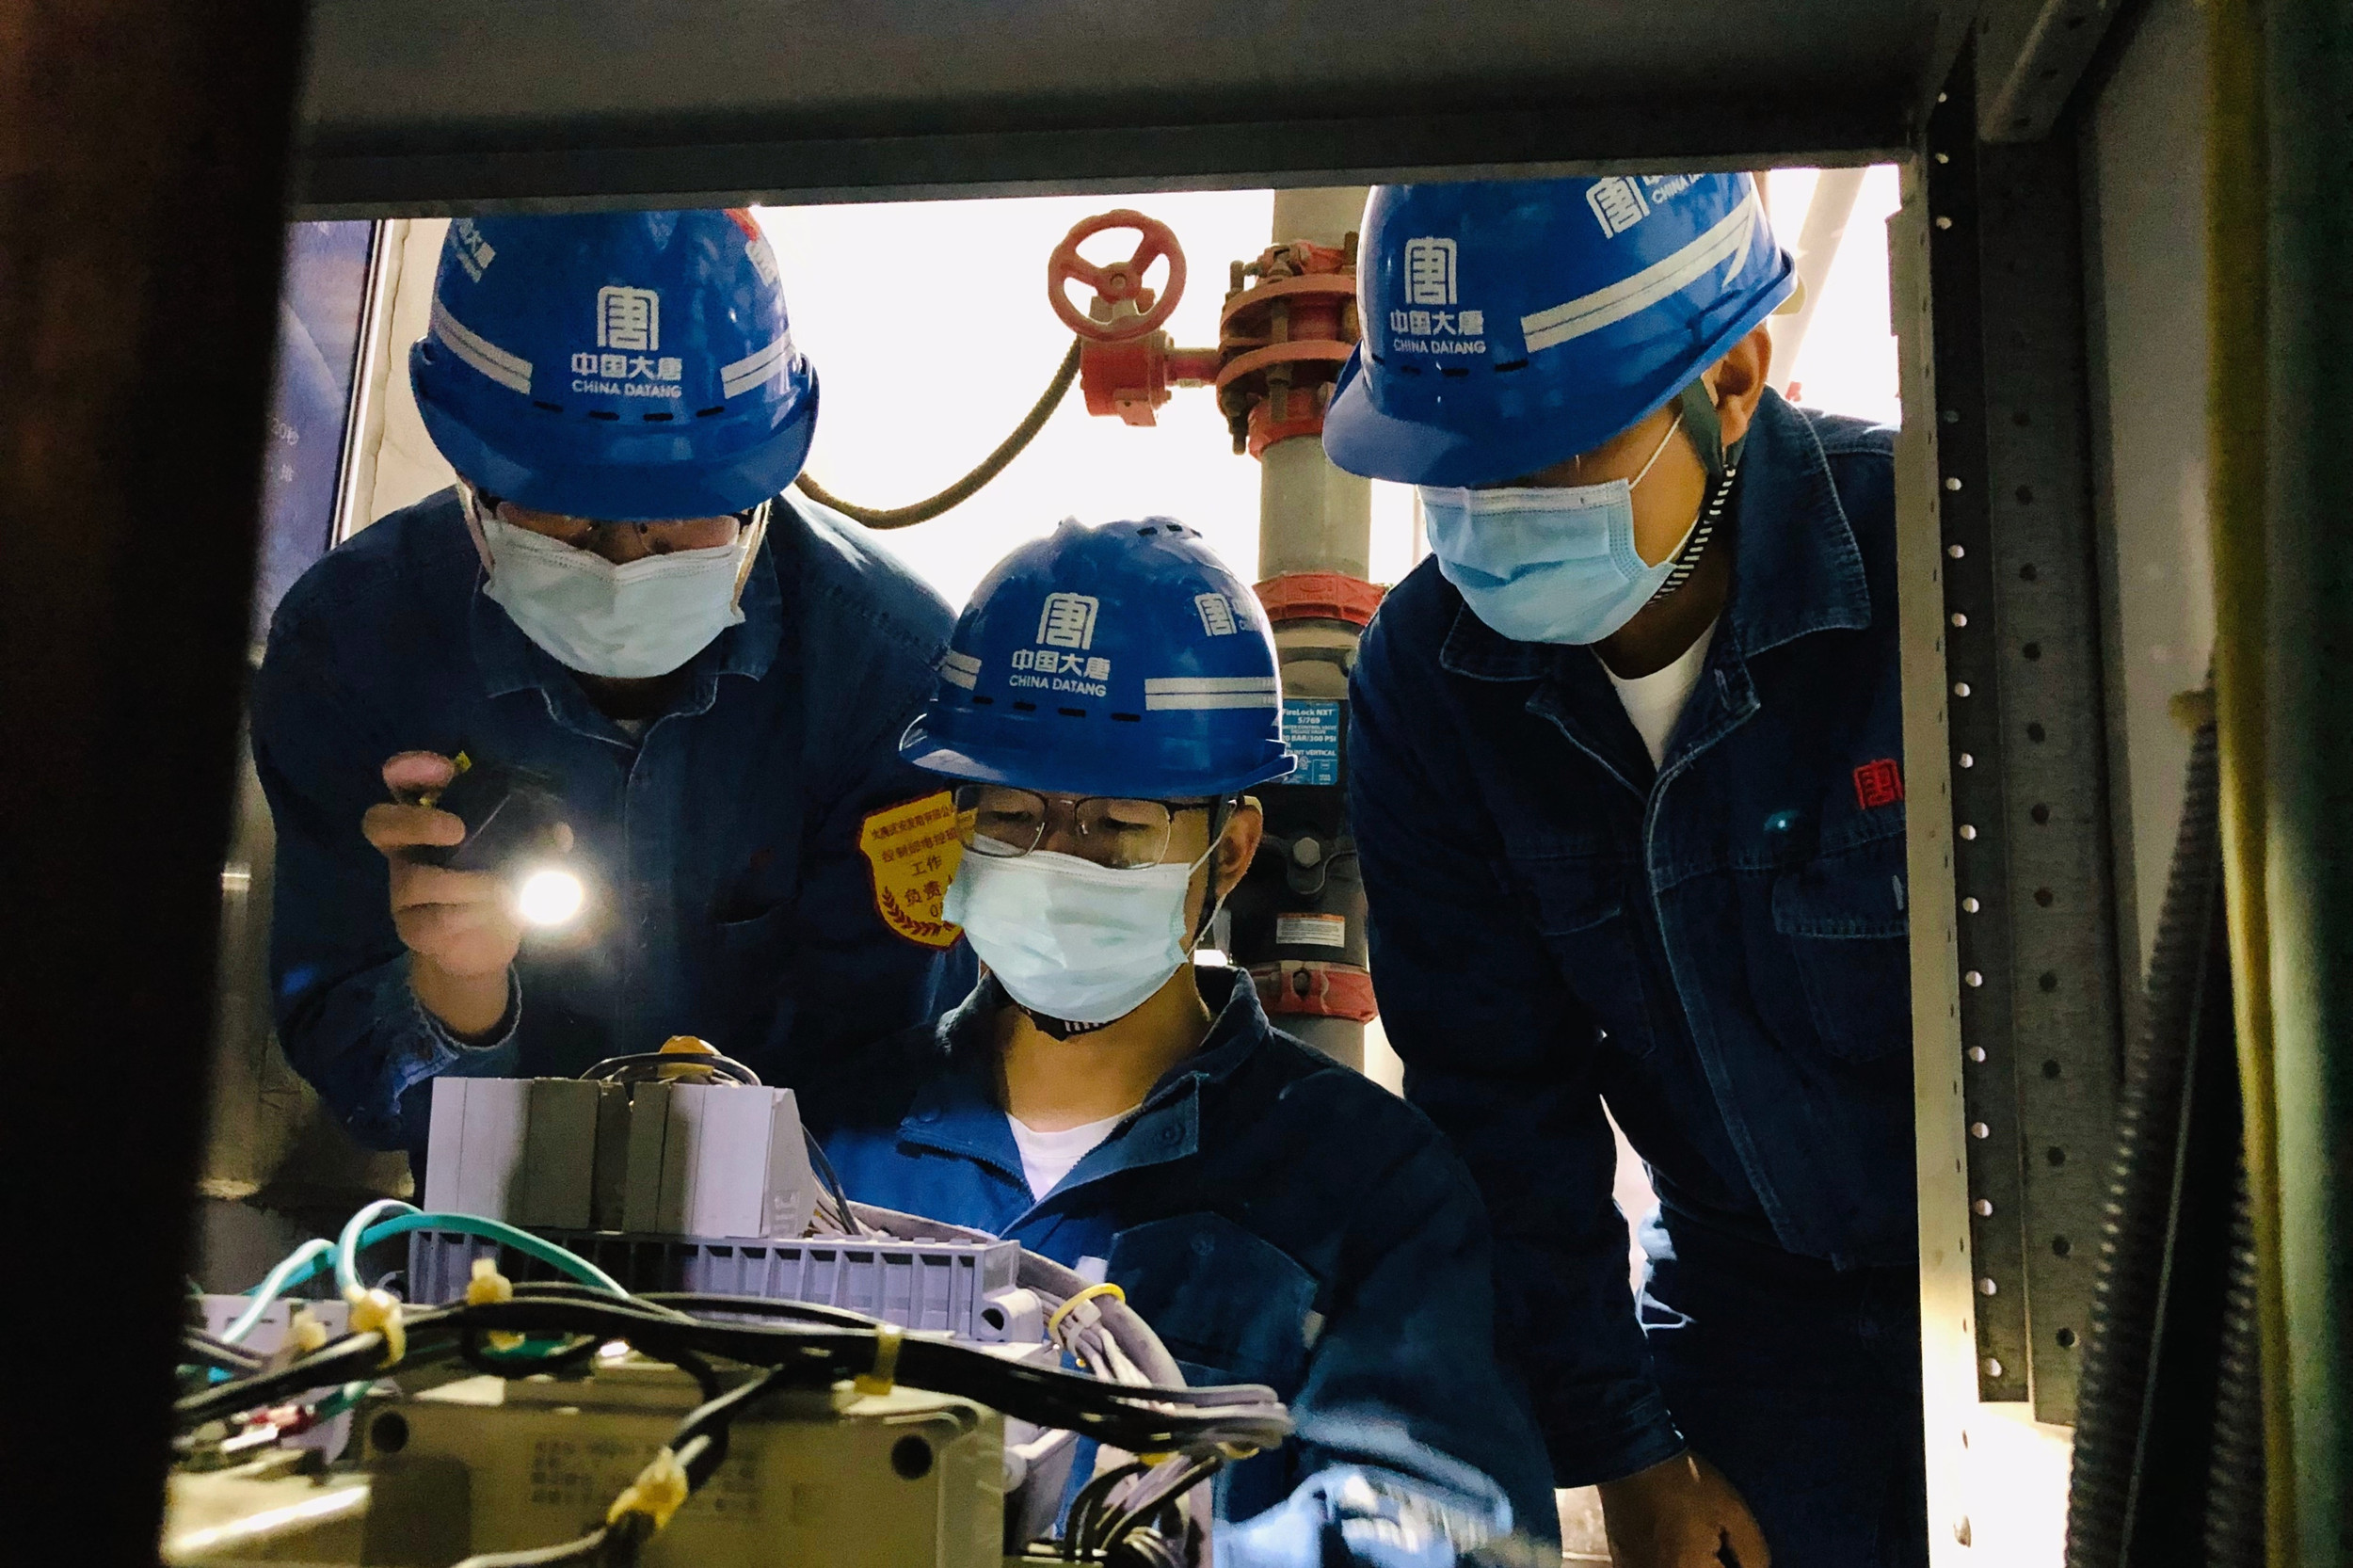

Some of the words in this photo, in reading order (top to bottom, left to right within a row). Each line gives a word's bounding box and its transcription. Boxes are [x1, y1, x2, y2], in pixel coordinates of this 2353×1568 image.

[1390, 310, 1484, 336] 中国大唐
[1393, 338, 1429, 354] CHINA
[1431, 340, 1486, 355] DATANG
[571, 352, 682, 381] 中国大唐
[571, 379, 621, 395] CHINA
[624, 381, 682, 398] DATANG
[1010, 649, 1112, 681] 中国大唐
[1009, 674, 1050, 690] CHINA
[1052, 677, 1108, 697] DATANG
[1317, 708, 1333, 716] NXT
[911, 854, 942, 877] 工作
[904, 874, 953, 907] 负责
